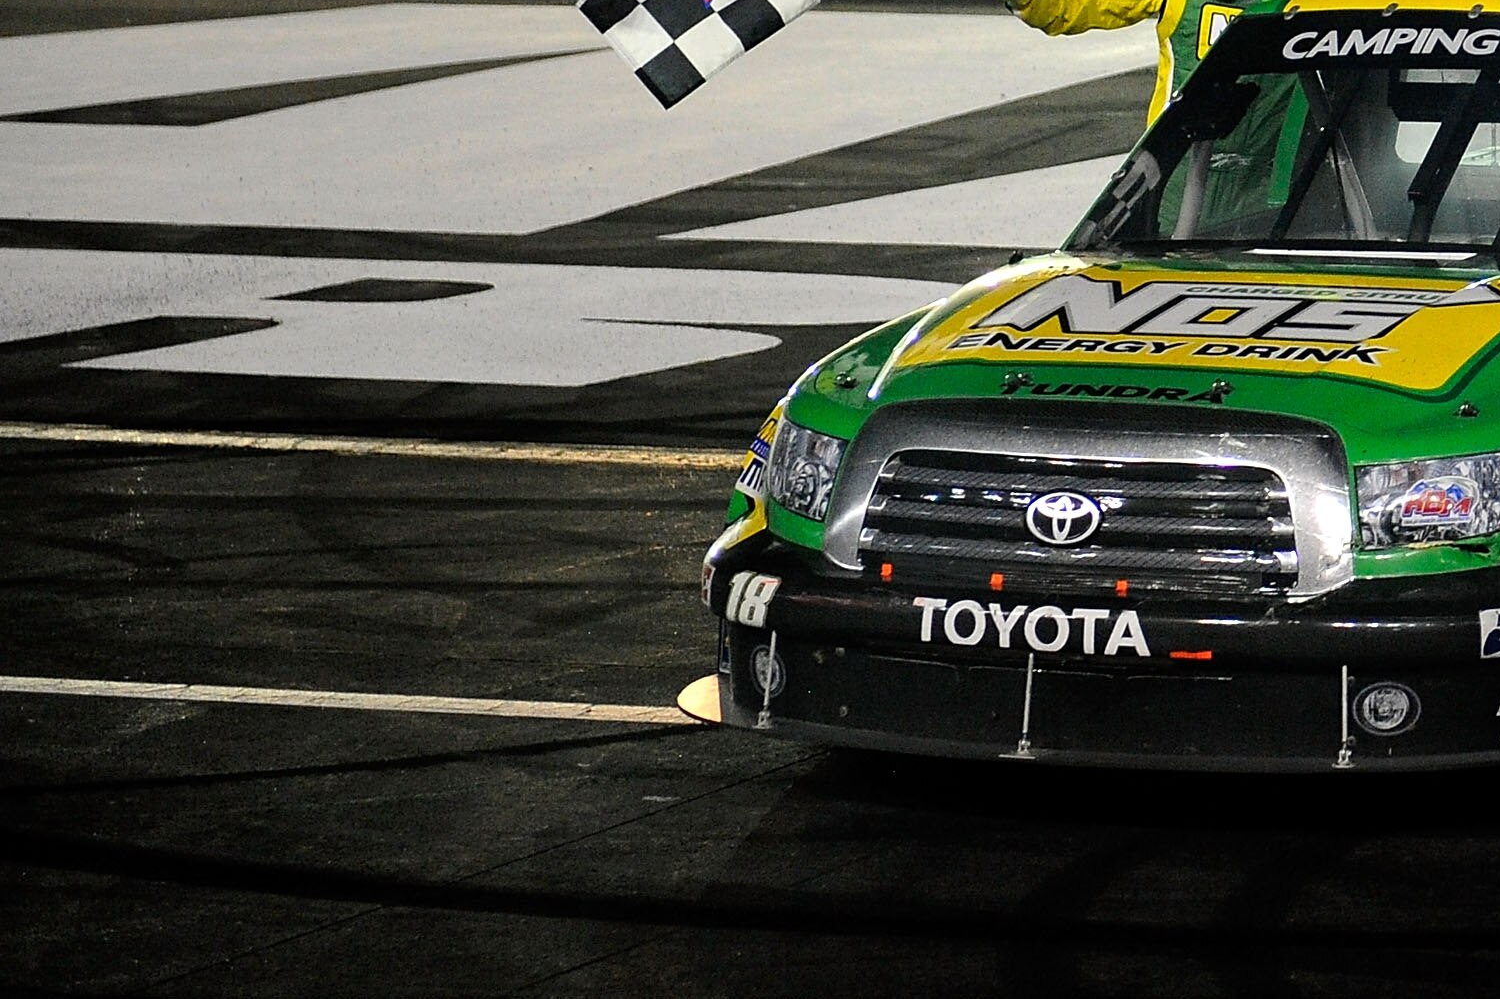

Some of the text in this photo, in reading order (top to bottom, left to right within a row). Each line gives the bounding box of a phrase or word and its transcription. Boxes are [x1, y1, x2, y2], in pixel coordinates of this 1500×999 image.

[973, 274, 1430, 345] NOS
[1186, 285, 1338, 298] CHARGED
[951, 333, 1393, 366] ENERGY DRINK
[998, 378, 1230, 405] TUNDRA
[725, 570, 783, 628] 18
[912, 597, 1151, 658] TOYOTA
